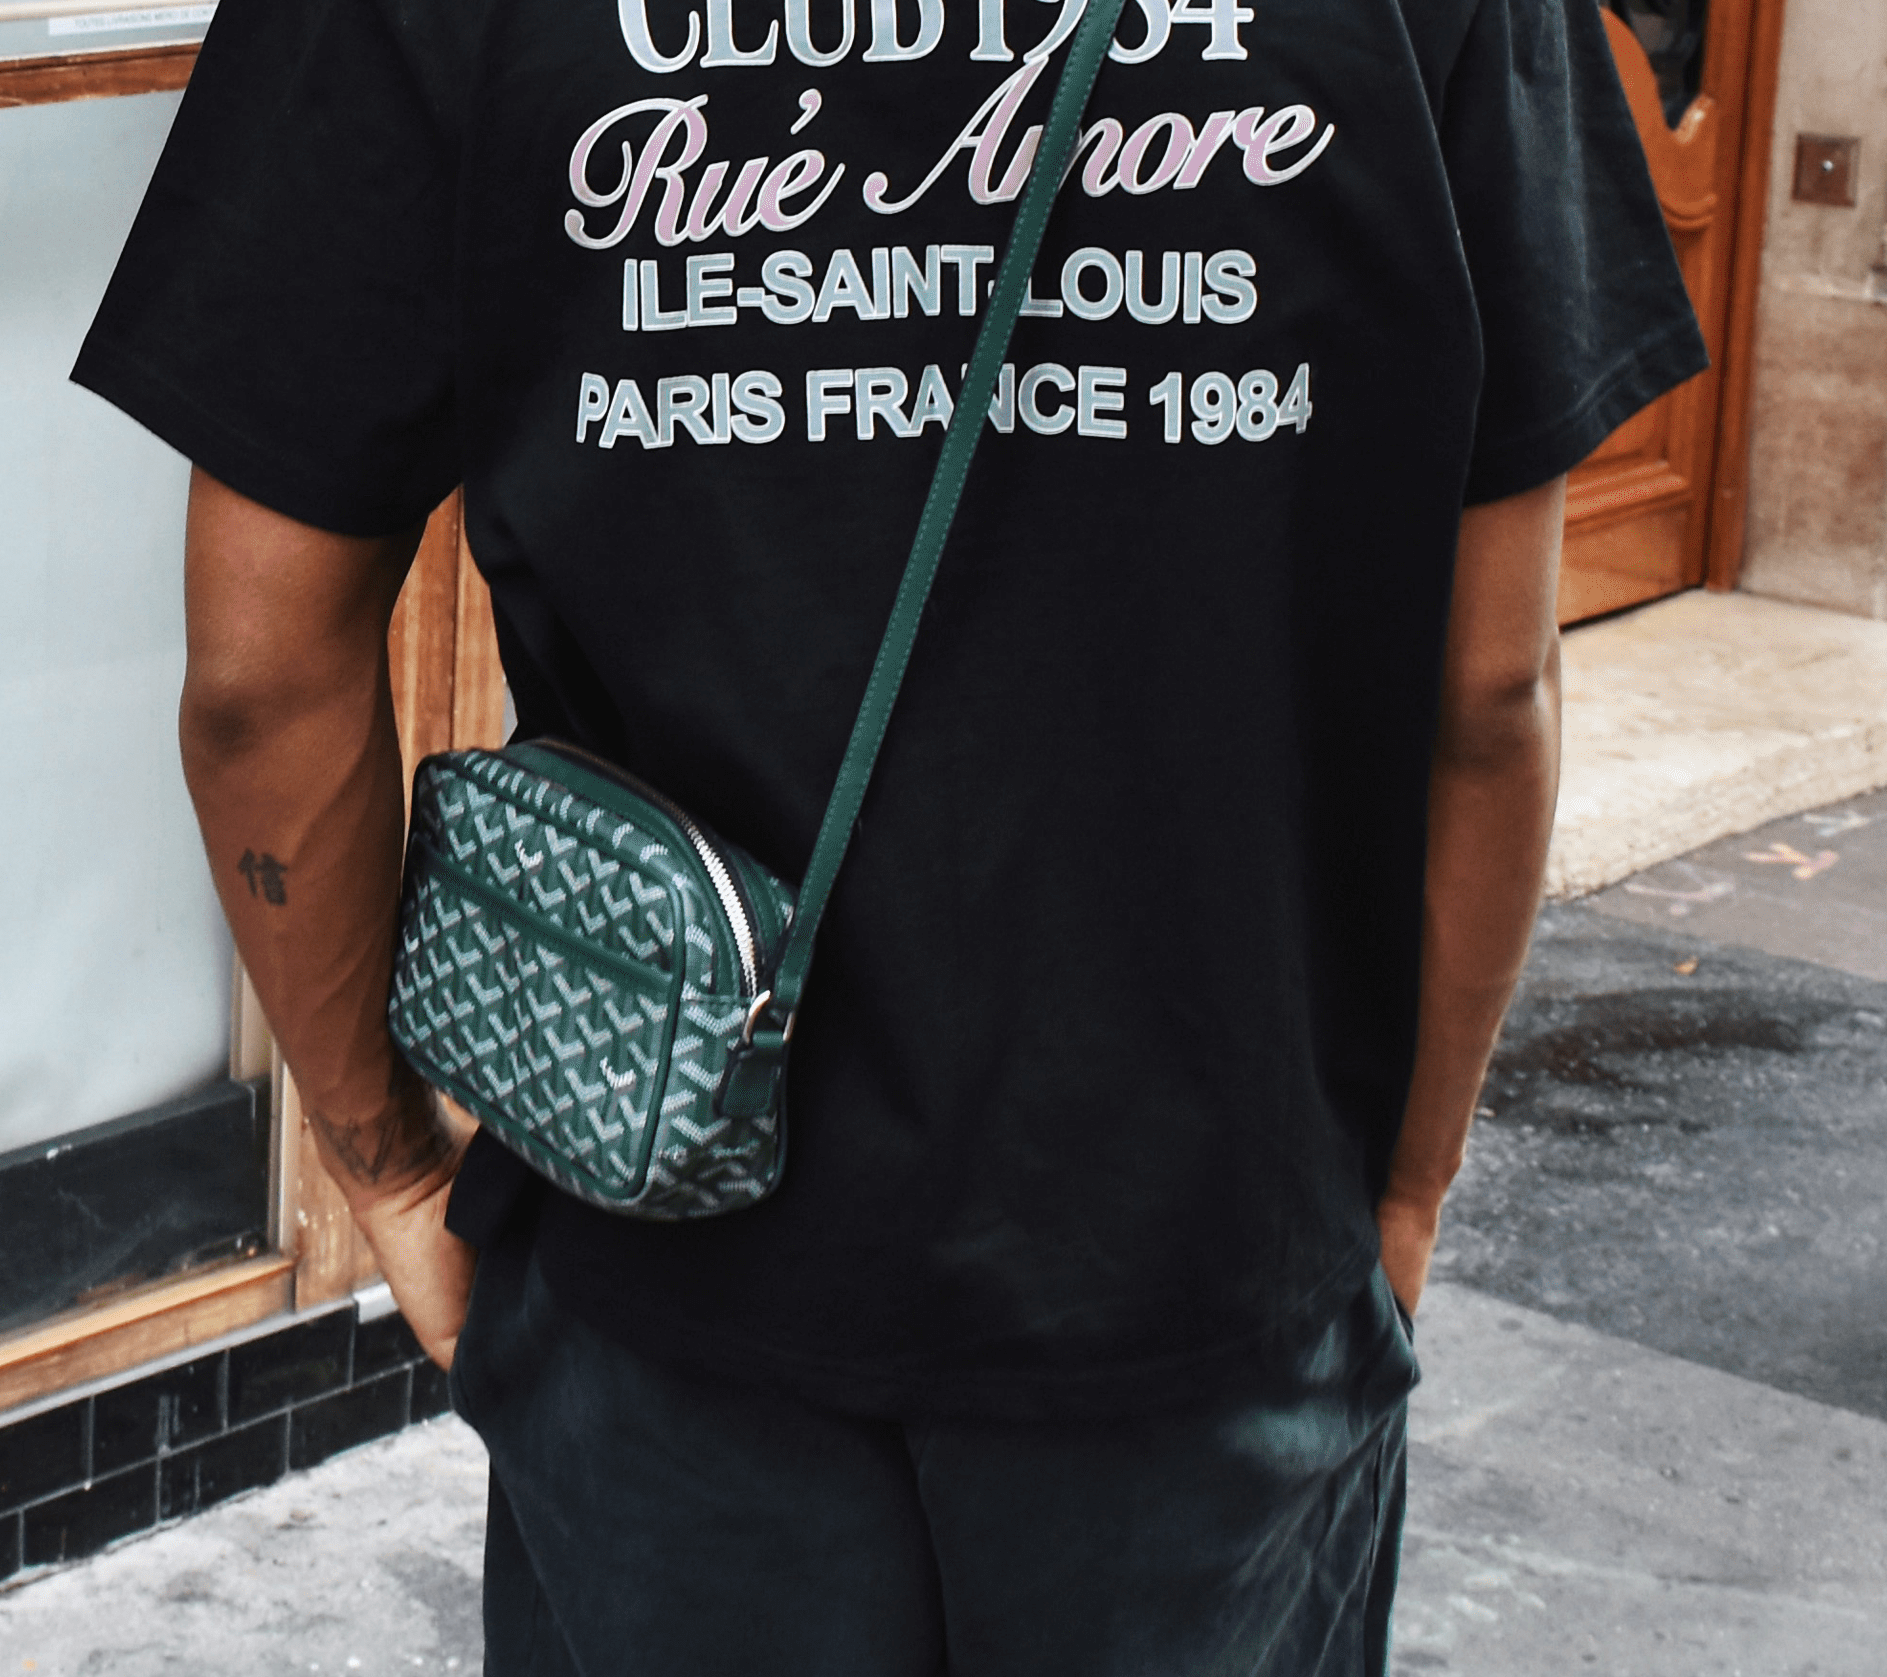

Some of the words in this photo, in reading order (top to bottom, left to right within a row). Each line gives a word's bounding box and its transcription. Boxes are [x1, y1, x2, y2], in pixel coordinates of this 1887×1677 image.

[564, 88, 846, 250] Rué
[622, 245, 1258, 331] ILE-SAINTOUIS
[576, 372, 786, 449] PARIS
[1148, 362, 1313, 445] 1984
